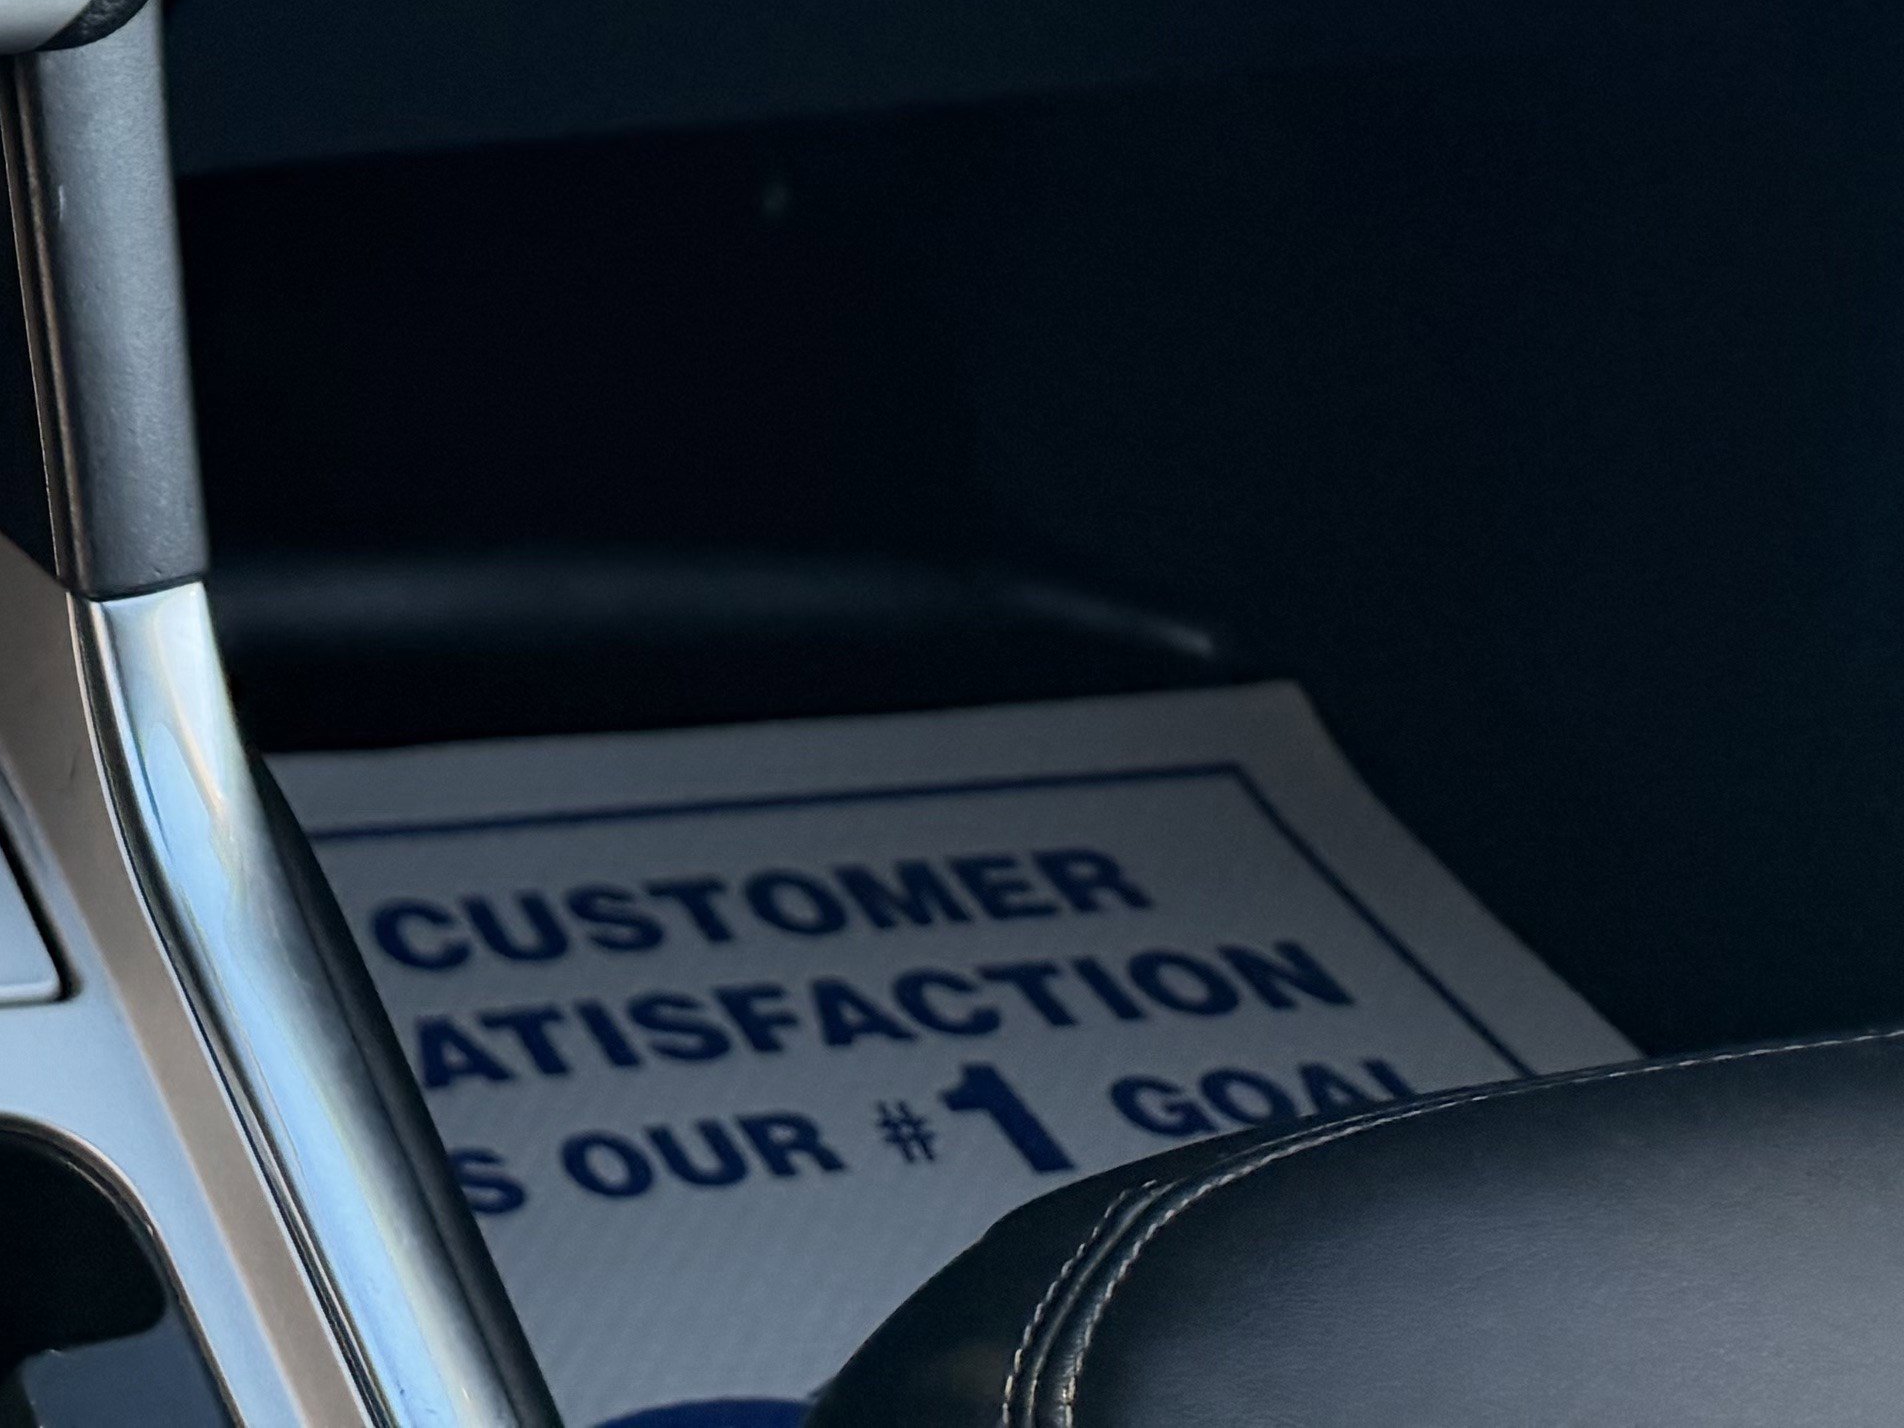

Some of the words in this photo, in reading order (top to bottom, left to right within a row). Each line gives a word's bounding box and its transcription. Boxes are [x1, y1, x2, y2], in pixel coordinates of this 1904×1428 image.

[373, 845, 1154, 972] CUSTOMER
[415, 939, 1355, 1090] ATISFACTION
[559, 1109, 848, 1199] OUR
